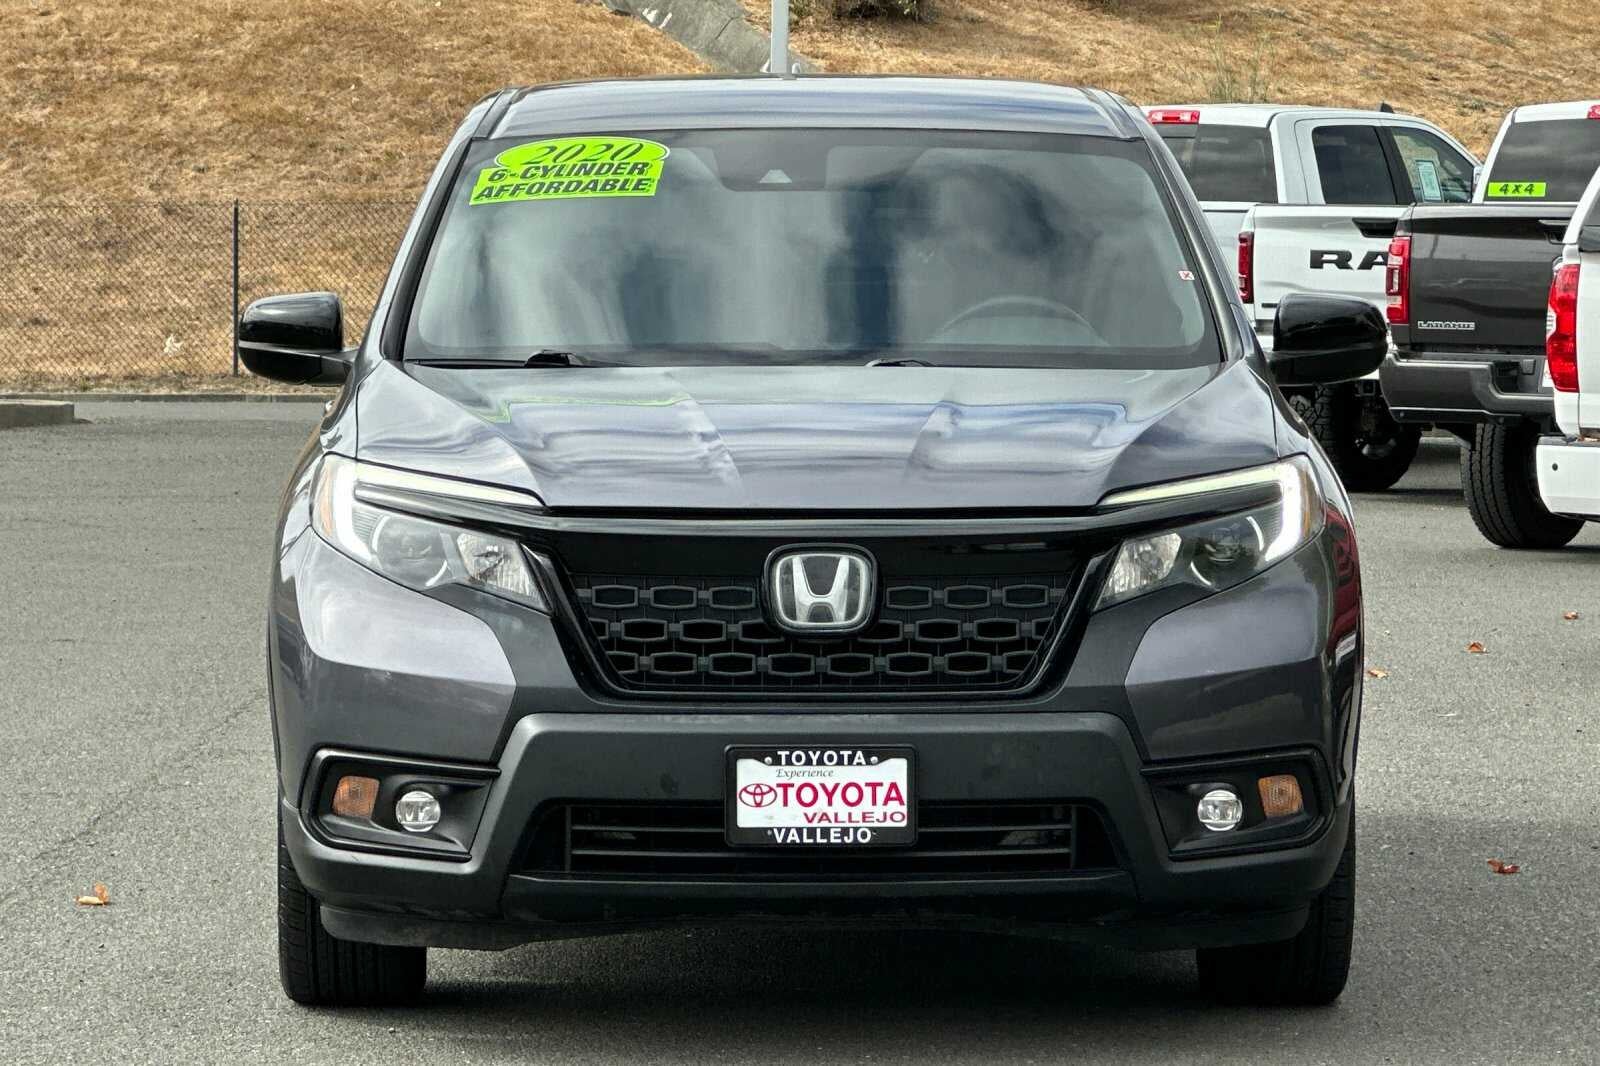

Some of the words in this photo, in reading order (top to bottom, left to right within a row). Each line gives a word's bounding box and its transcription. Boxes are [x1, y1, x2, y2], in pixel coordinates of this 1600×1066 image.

[522, 143, 644, 164] 2020
[488, 161, 650, 183] 6-CYLINDER
[474, 178, 654, 199] AFFORDABLE
[1310, 249, 1389, 270] RA
[1417, 321, 1475, 330] LARAMIE
[777, 750, 866, 766] TOYOTA
[776, 768, 834, 780] Experience
[776, 782, 905, 808] TOYOTA
[803, 811, 906, 824] VALLEJO
[772, 828, 872, 843] VALLEJO
